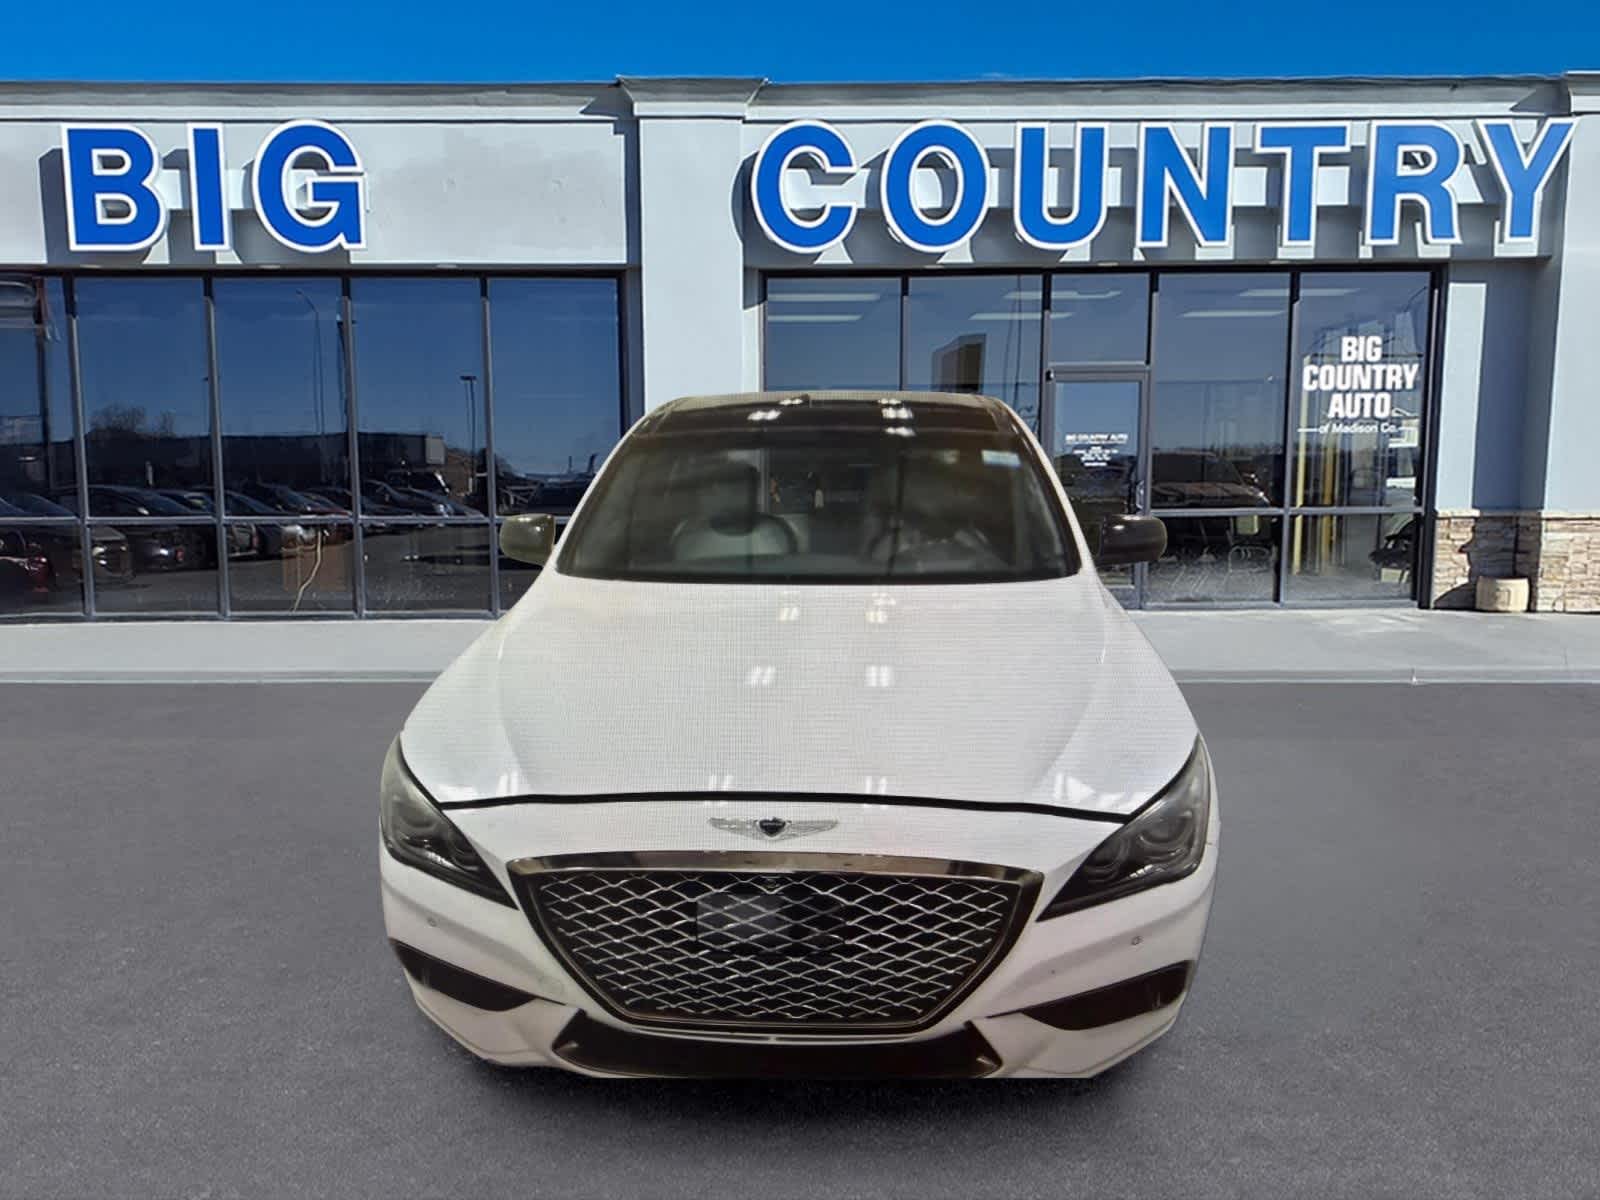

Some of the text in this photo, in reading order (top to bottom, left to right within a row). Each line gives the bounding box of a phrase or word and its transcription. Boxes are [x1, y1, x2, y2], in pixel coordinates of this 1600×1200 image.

[61, 118, 1577, 254] BIG COUNTRY
[1341, 336, 1382, 362] BIG
[1302, 363, 1419, 391] COUNTRY
[1328, 392, 1391, 419] AUTO
